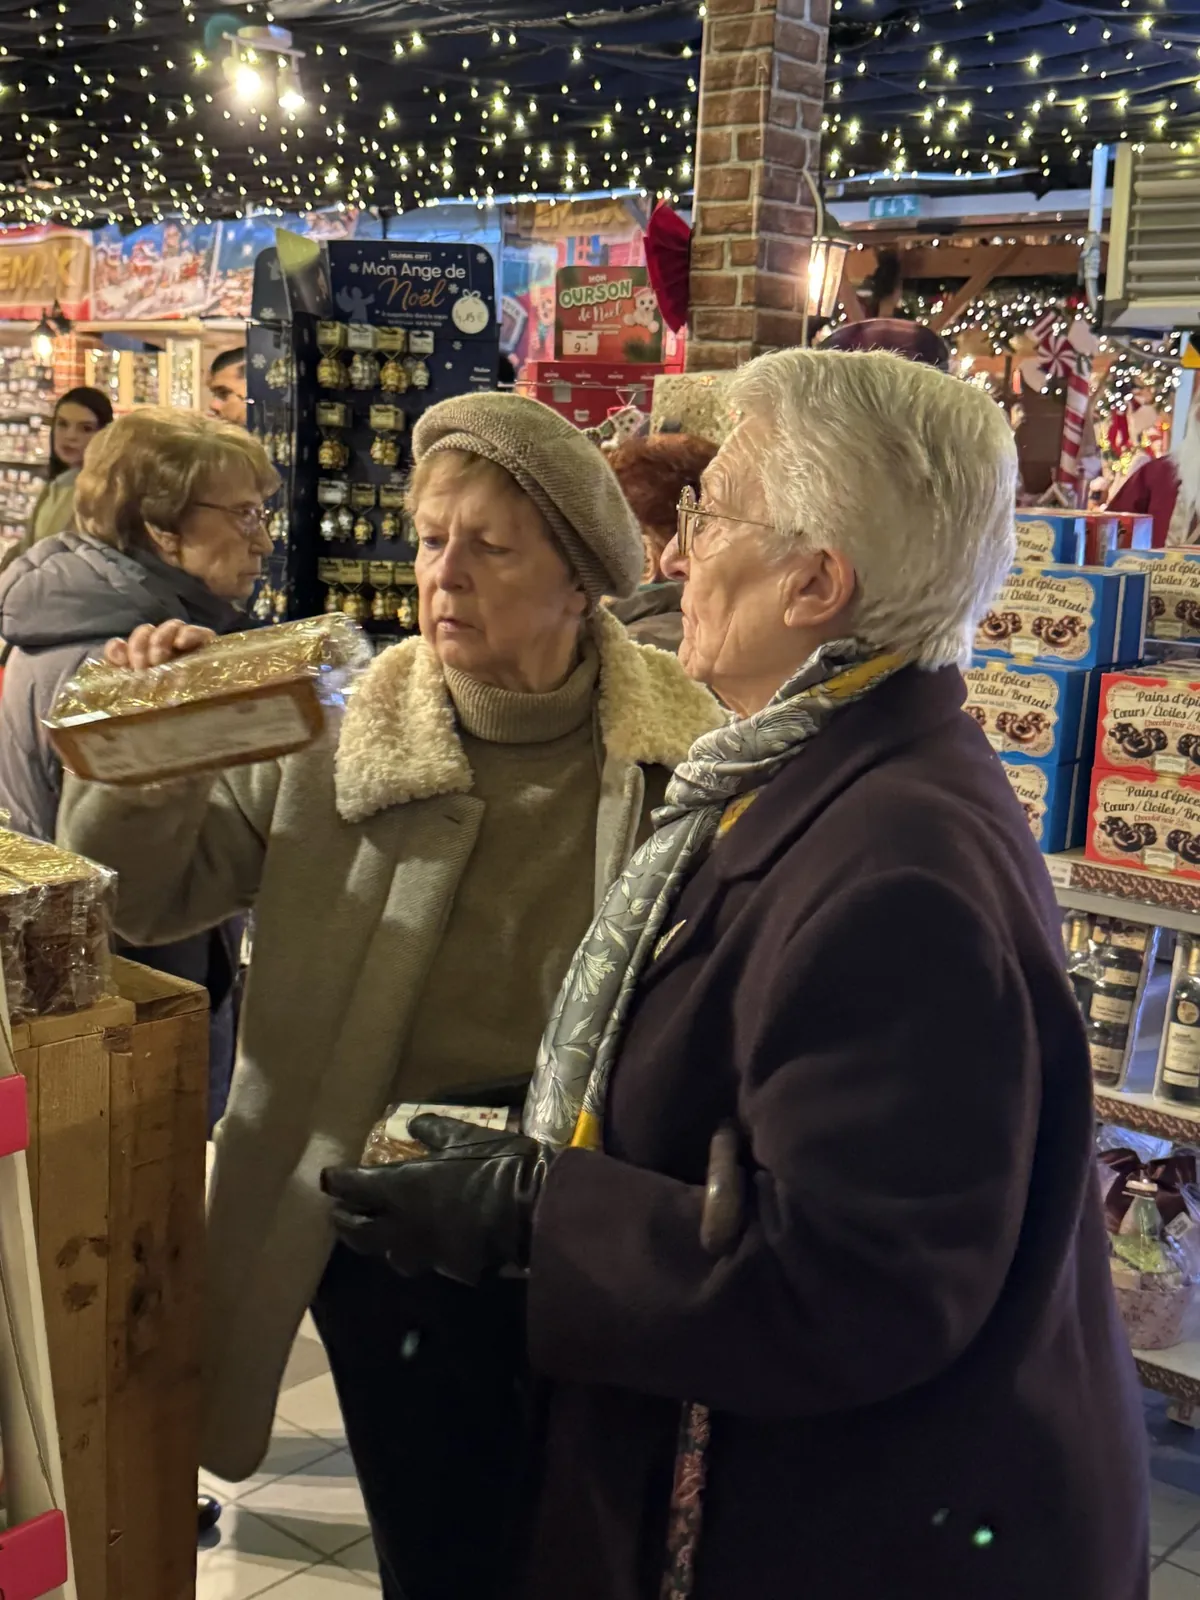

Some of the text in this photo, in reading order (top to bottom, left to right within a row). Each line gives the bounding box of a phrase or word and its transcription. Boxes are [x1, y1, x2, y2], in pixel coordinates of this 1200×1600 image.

[362, 262, 466, 281] Mon Ange de
[588, 274, 607, 283] MON
[378, 277, 446, 310] Noël
[559, 279, 633, 308] OURSON
[579, 306, 592, 322] de
[1027, 577, 1066, 593] d'épices
[1047, 593, 1087, 613] Bretzels
[964, 670, 1031, 690] ains d'épices
[1012, 688, 1051, 709] Bretzels
[1136, 690, 1170, 704] Pains
[1111, 707, 1146, 720] Cœurs
[1153, 703, 1187, 720] Étoiles
[1126, 785, 1159, 800] Pains
[1101, 801, 1136, 813] Cœurs
[1142, 797, 1176, 816] Étoiles
